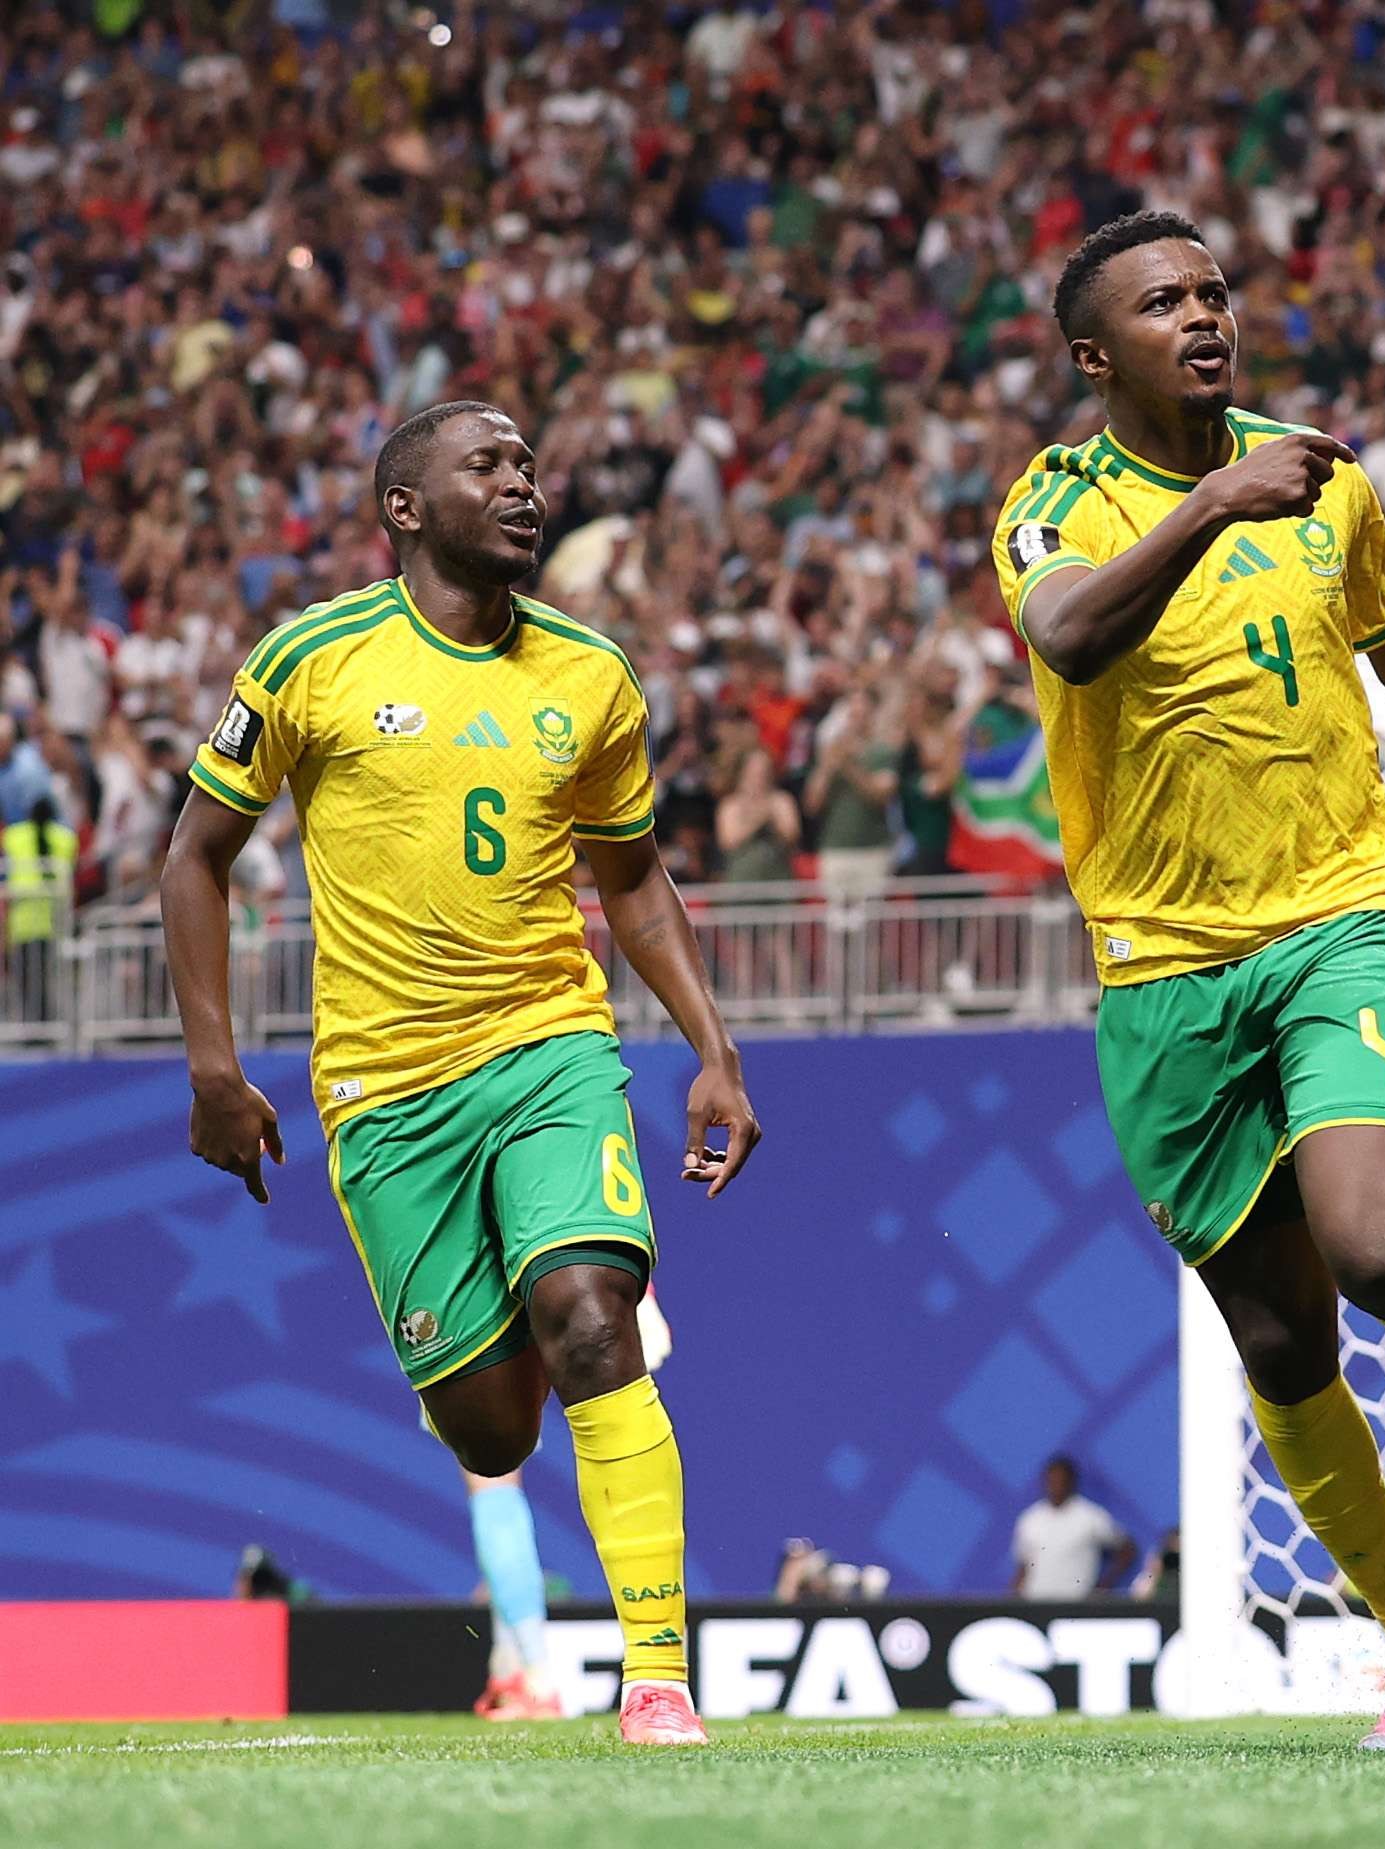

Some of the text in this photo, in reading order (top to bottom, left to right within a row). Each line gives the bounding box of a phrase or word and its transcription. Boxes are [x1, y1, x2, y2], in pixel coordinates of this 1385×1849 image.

[1243, 615, 1298, 706] 4
[464, 787, 506, 876] 6
[602, 1132, 642, 1217] 6
[622, 1581, 682, 1603] SAFA
[546, 1617, 898, 1718] FFA
